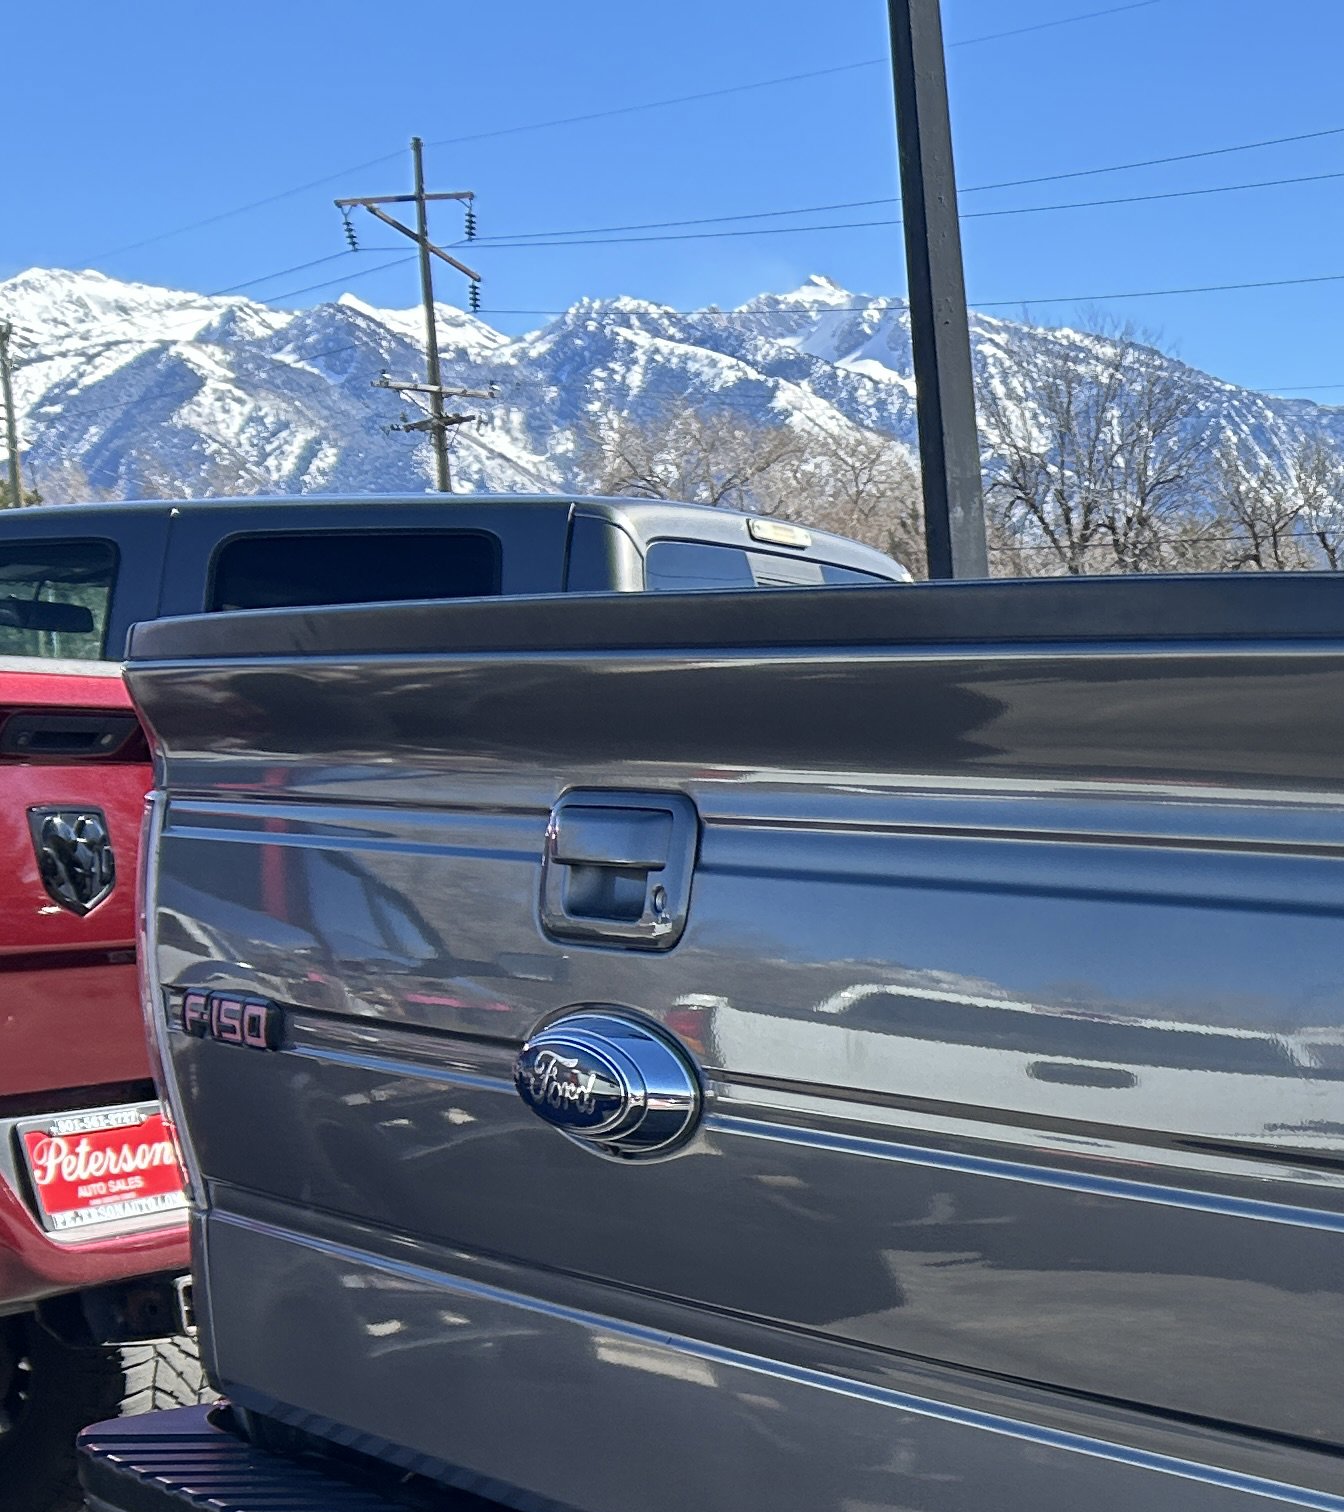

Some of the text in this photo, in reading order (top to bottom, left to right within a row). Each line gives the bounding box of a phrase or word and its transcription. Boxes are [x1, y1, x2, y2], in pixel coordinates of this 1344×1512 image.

[183, 993, 268, 1048] F-150
[529, 1049, 597, 1115] Ford
[33, 1137, 177, 1185] Peterson
[77, 1176, 144, 1198] AUTO SALES
